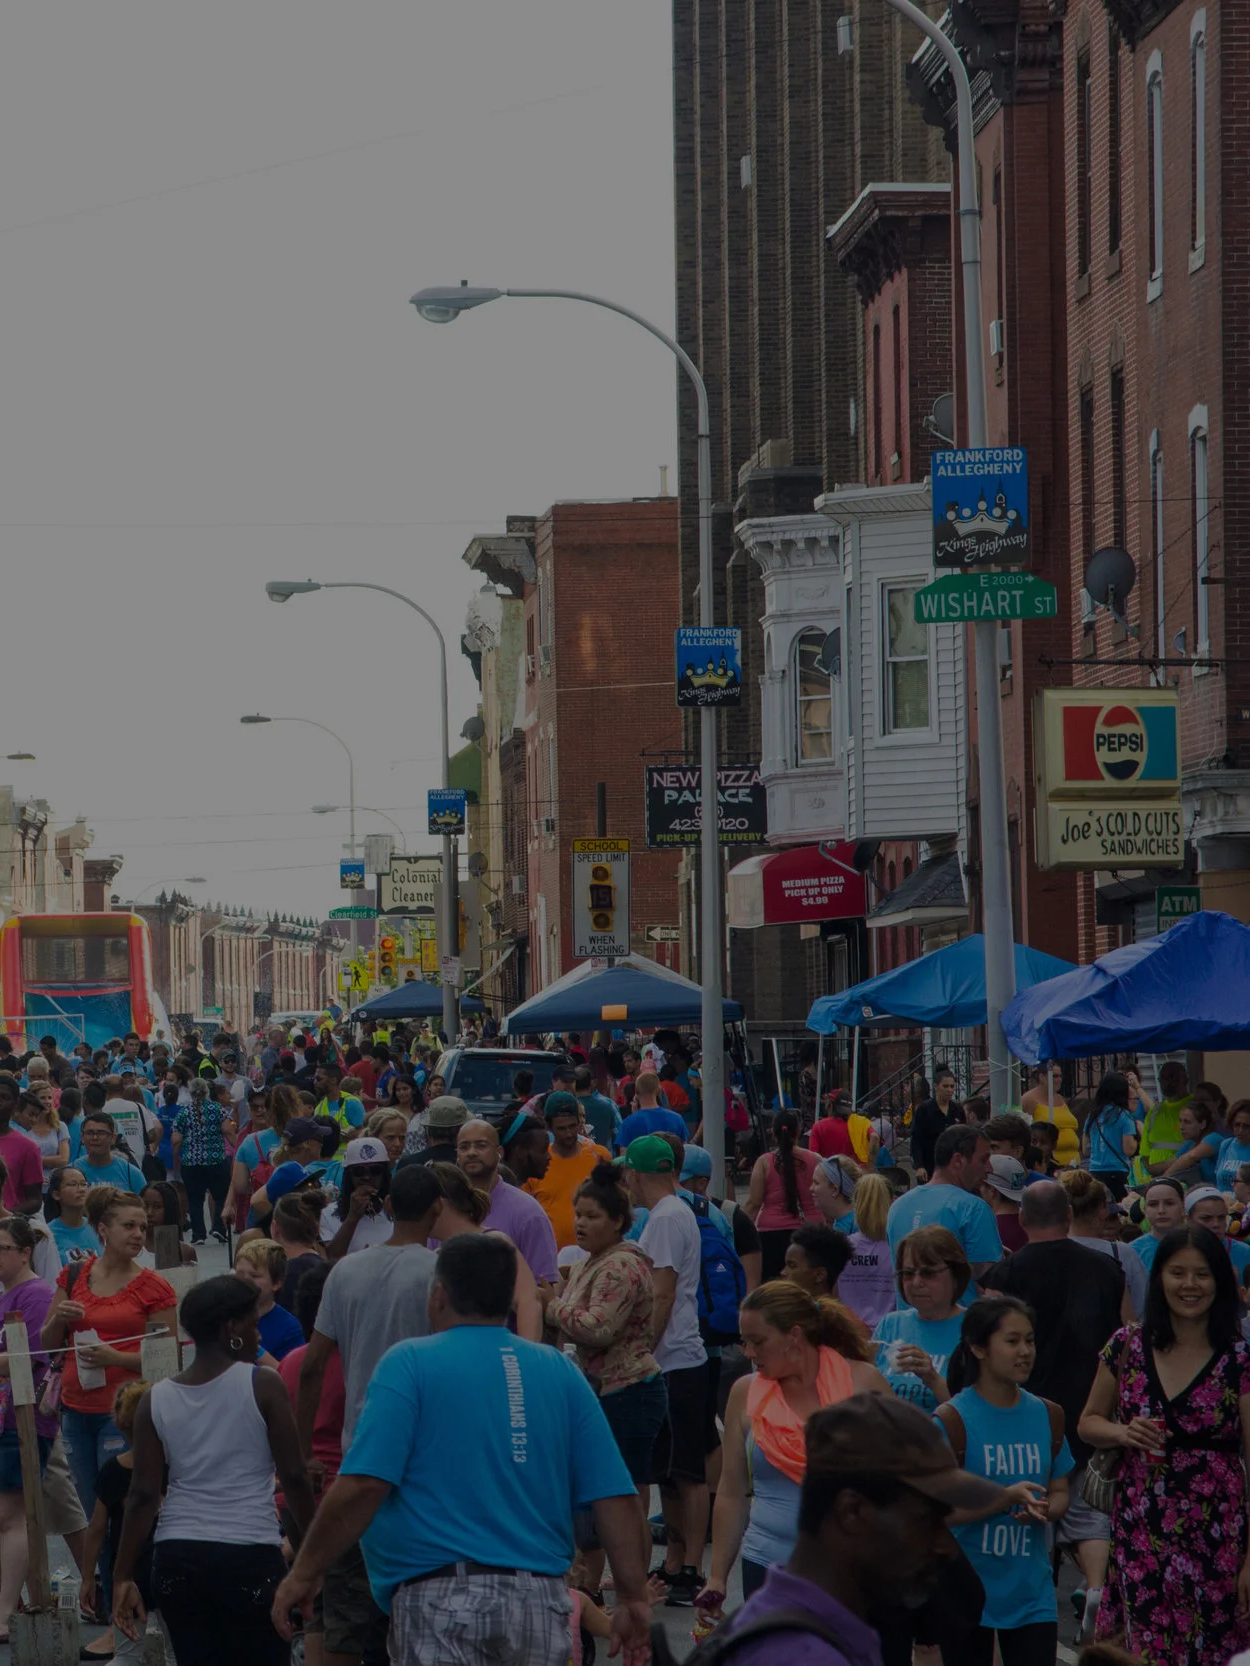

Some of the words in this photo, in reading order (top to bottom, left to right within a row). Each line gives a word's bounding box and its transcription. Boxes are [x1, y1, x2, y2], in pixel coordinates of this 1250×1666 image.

[936, 449, 1023, 464] FRANKFORD
[937, 462, 1023, 477] ALLEGHENY
[936, 536, 977, 557] Kings
[964, 533, 1027, 562] Highway
[980, 575, 989, 587] E
[992, 575, 1023, 585] 2000
[920, 590, 1024, 618] WISHART
[1034, 596, 1052, 614] ST
[680, 628, 738, 637] FRANKFORD
[1096, 733, 1143, 752] PEPSI
[652, 771, 700, 788] NEW
[669, 818, 749, 831] 423120
[1061, 810, 1104, 845] Joe's
[1106, 812, 1142, 836] COLD
[1145, 812, 1180, 836] CUTS
[656, 833, 698, 842] PICK-UP
[580, 842, 623, 851] SCHOOL
[1101, 838, 1180, 855] SANDWICHES
[577, 854, 603, 863] SPEED
[606, 853, 626, 862] LIMIT
[392, 868, 441, 884] Colonial
[782, 877, 819, 888] MEDIUM
[820, 875, 845, 885] PIZZA
[784, 888, 806, 897] PICK
[808, 887, 820, 895] UP
[822, 885, 843, 894] ONLY
[802, 896, 829, 906] $4.99
[1161, 895, 1197, 912] ATM
[331, 910, 367, 919] Clearfield
[589, 936, 616, 945] WHEN
[579, 945, 625, 955] FLASHING
[851, 1255, 879, 1267] CREW
[502, 1354, 527, 1428] CORINTHIANS
[511, 1432, 528, 1463] 13:13
[983, 1444, 1041, 1476] FAITH
[981, 1523, 1031, 1557] LOVE
